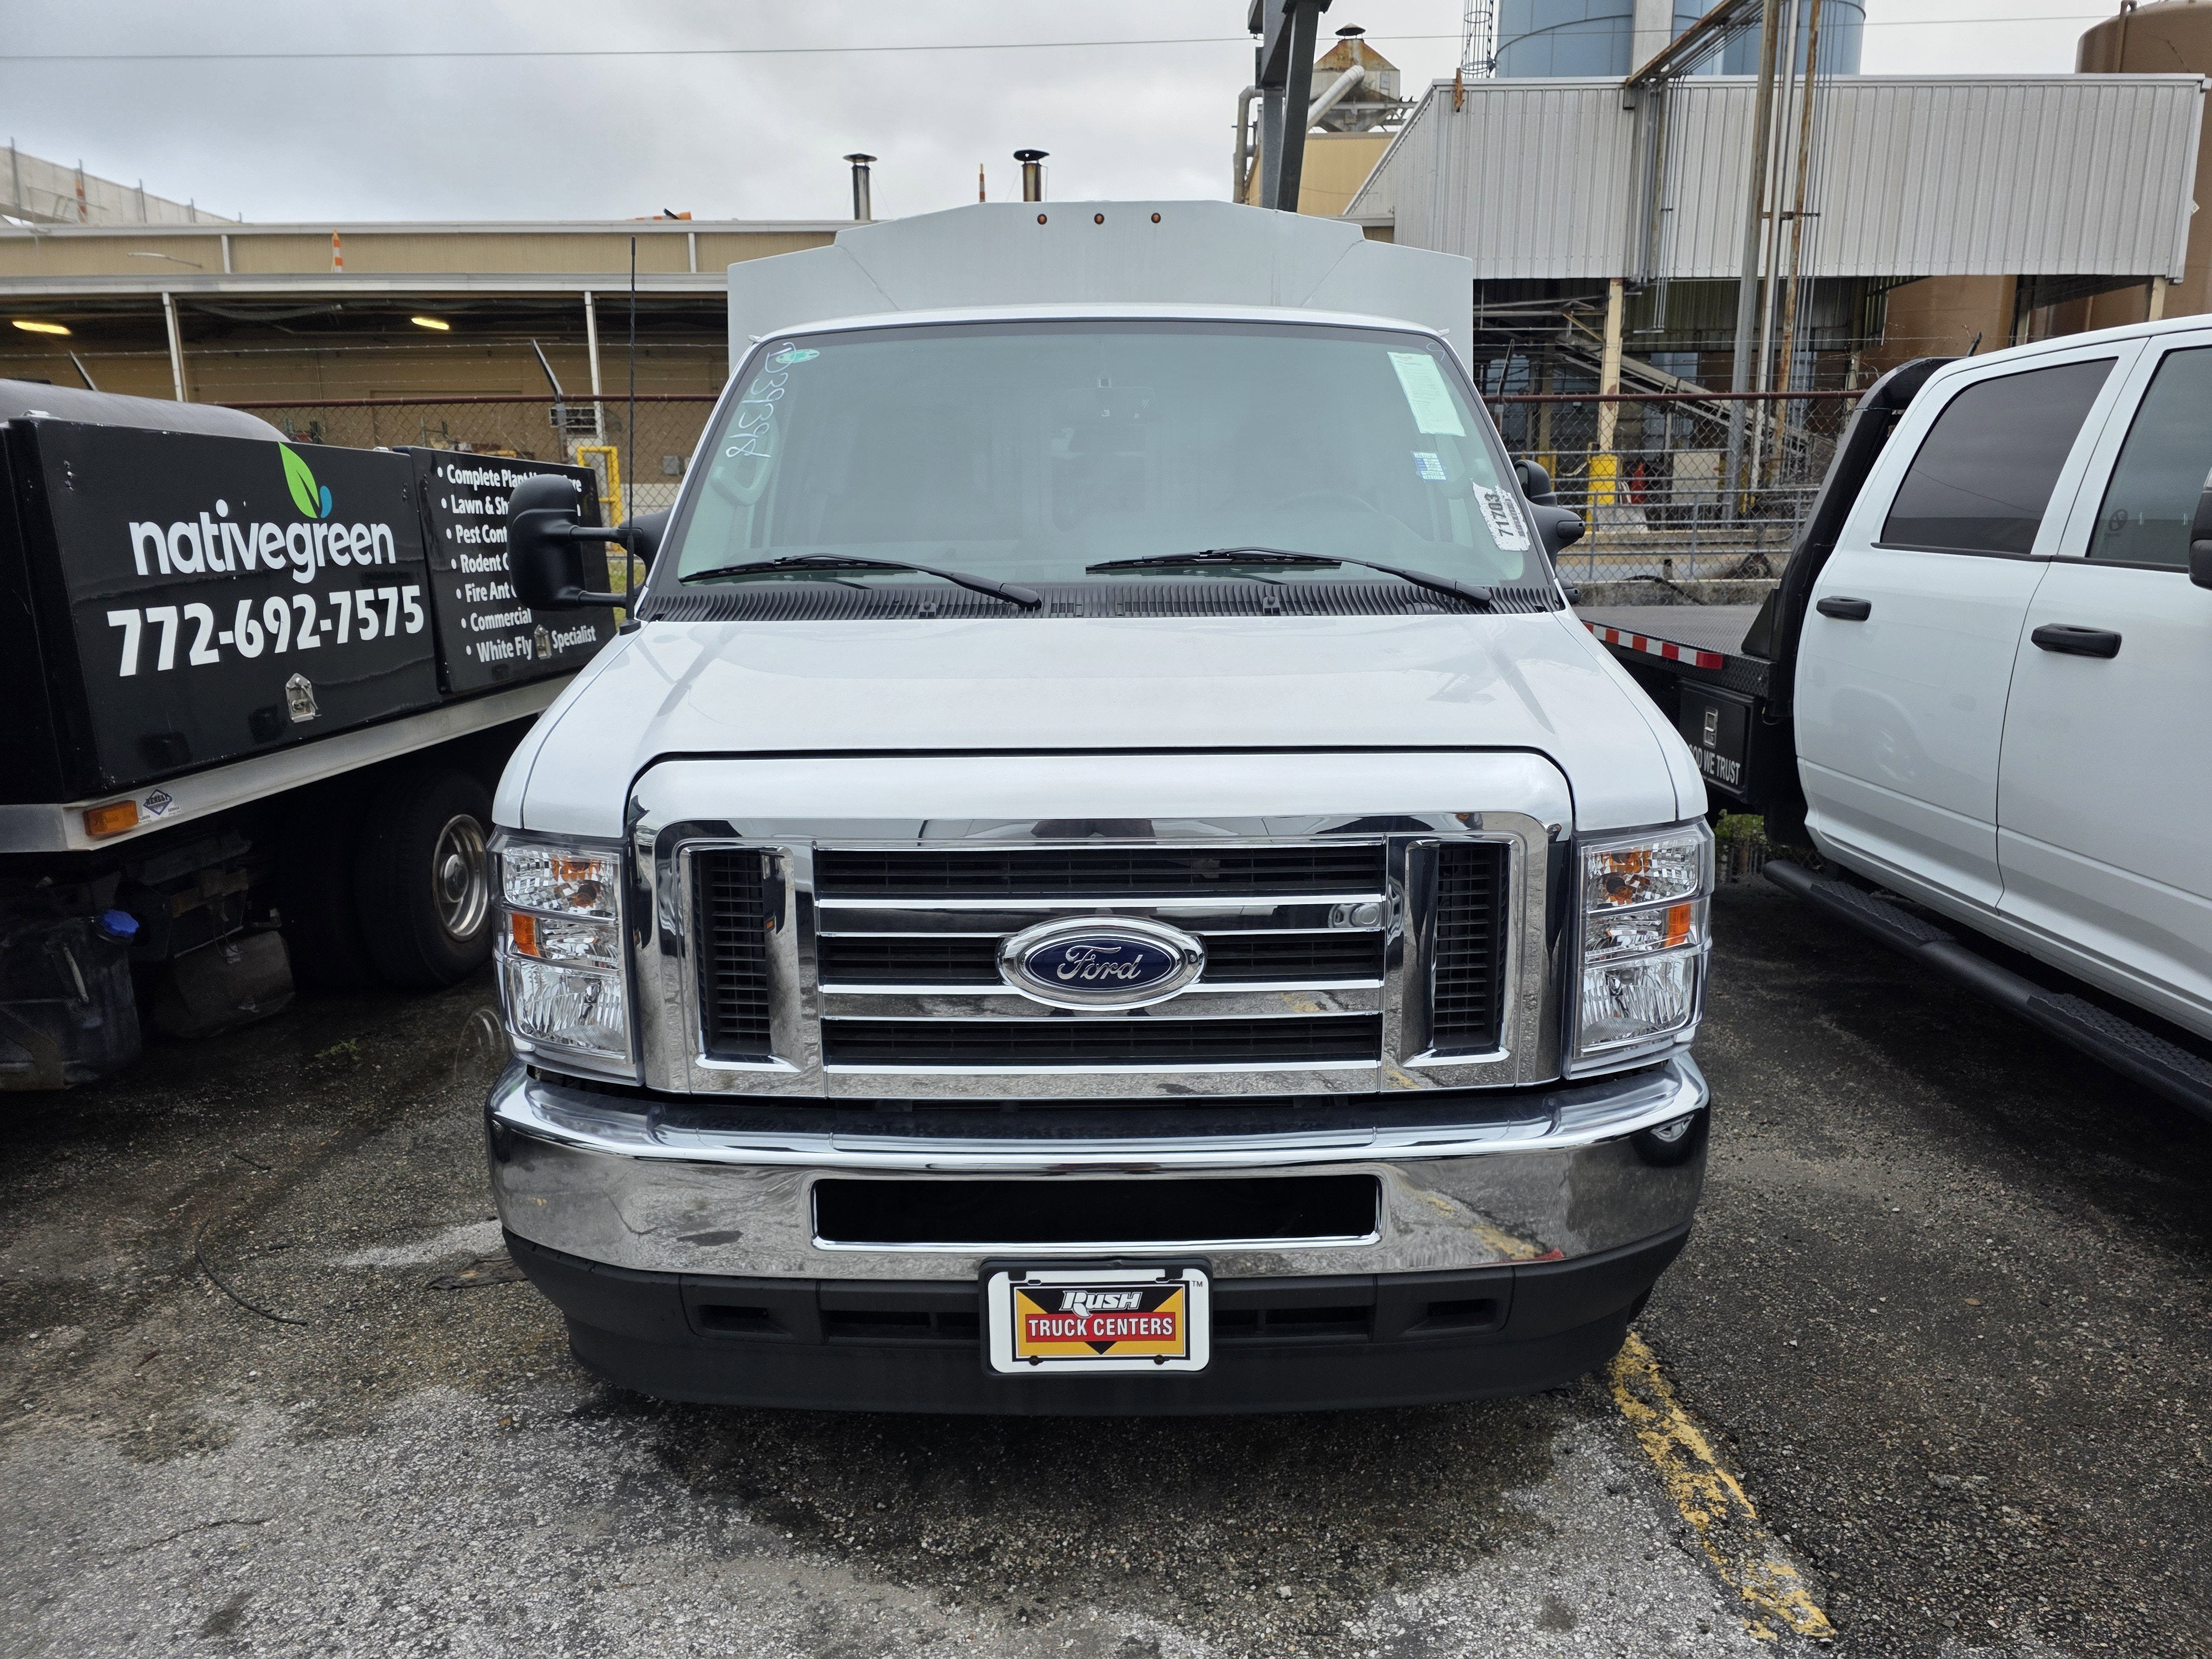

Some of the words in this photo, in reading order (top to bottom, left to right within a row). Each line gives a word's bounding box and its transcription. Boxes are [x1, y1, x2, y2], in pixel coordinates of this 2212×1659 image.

[726, 342, 796, 458] D39398
[447, 464, 501, 491] Complete
[451, 494, 483, 514] Lawn
[485, 496, 494, 515] &
[129, 499, 396, 584] nativegreen
[456, 524, 481, 544] Pest
[460, 554, 502, 573] Rodent
[465, 582, 488, 603] Fire
[490, 582, 510, 600] Ant
[107, 585, 425, 677] 772-692-7575
[471, 607, 532, 632] Commercial
[476, 639, 514, 662] White
[514, 636, 533, 660] Fly
[552, 625, 596, 654] Specialist
[1704, 749, 1715, 775] WE
[1716, 755, 1740, 785] TRUST
[1056, 945, 1143, 980] Ford
[1029, 1319, 1088, 1337] TRUCK
[1093, 1317, 1173, 1336] CENTERS
